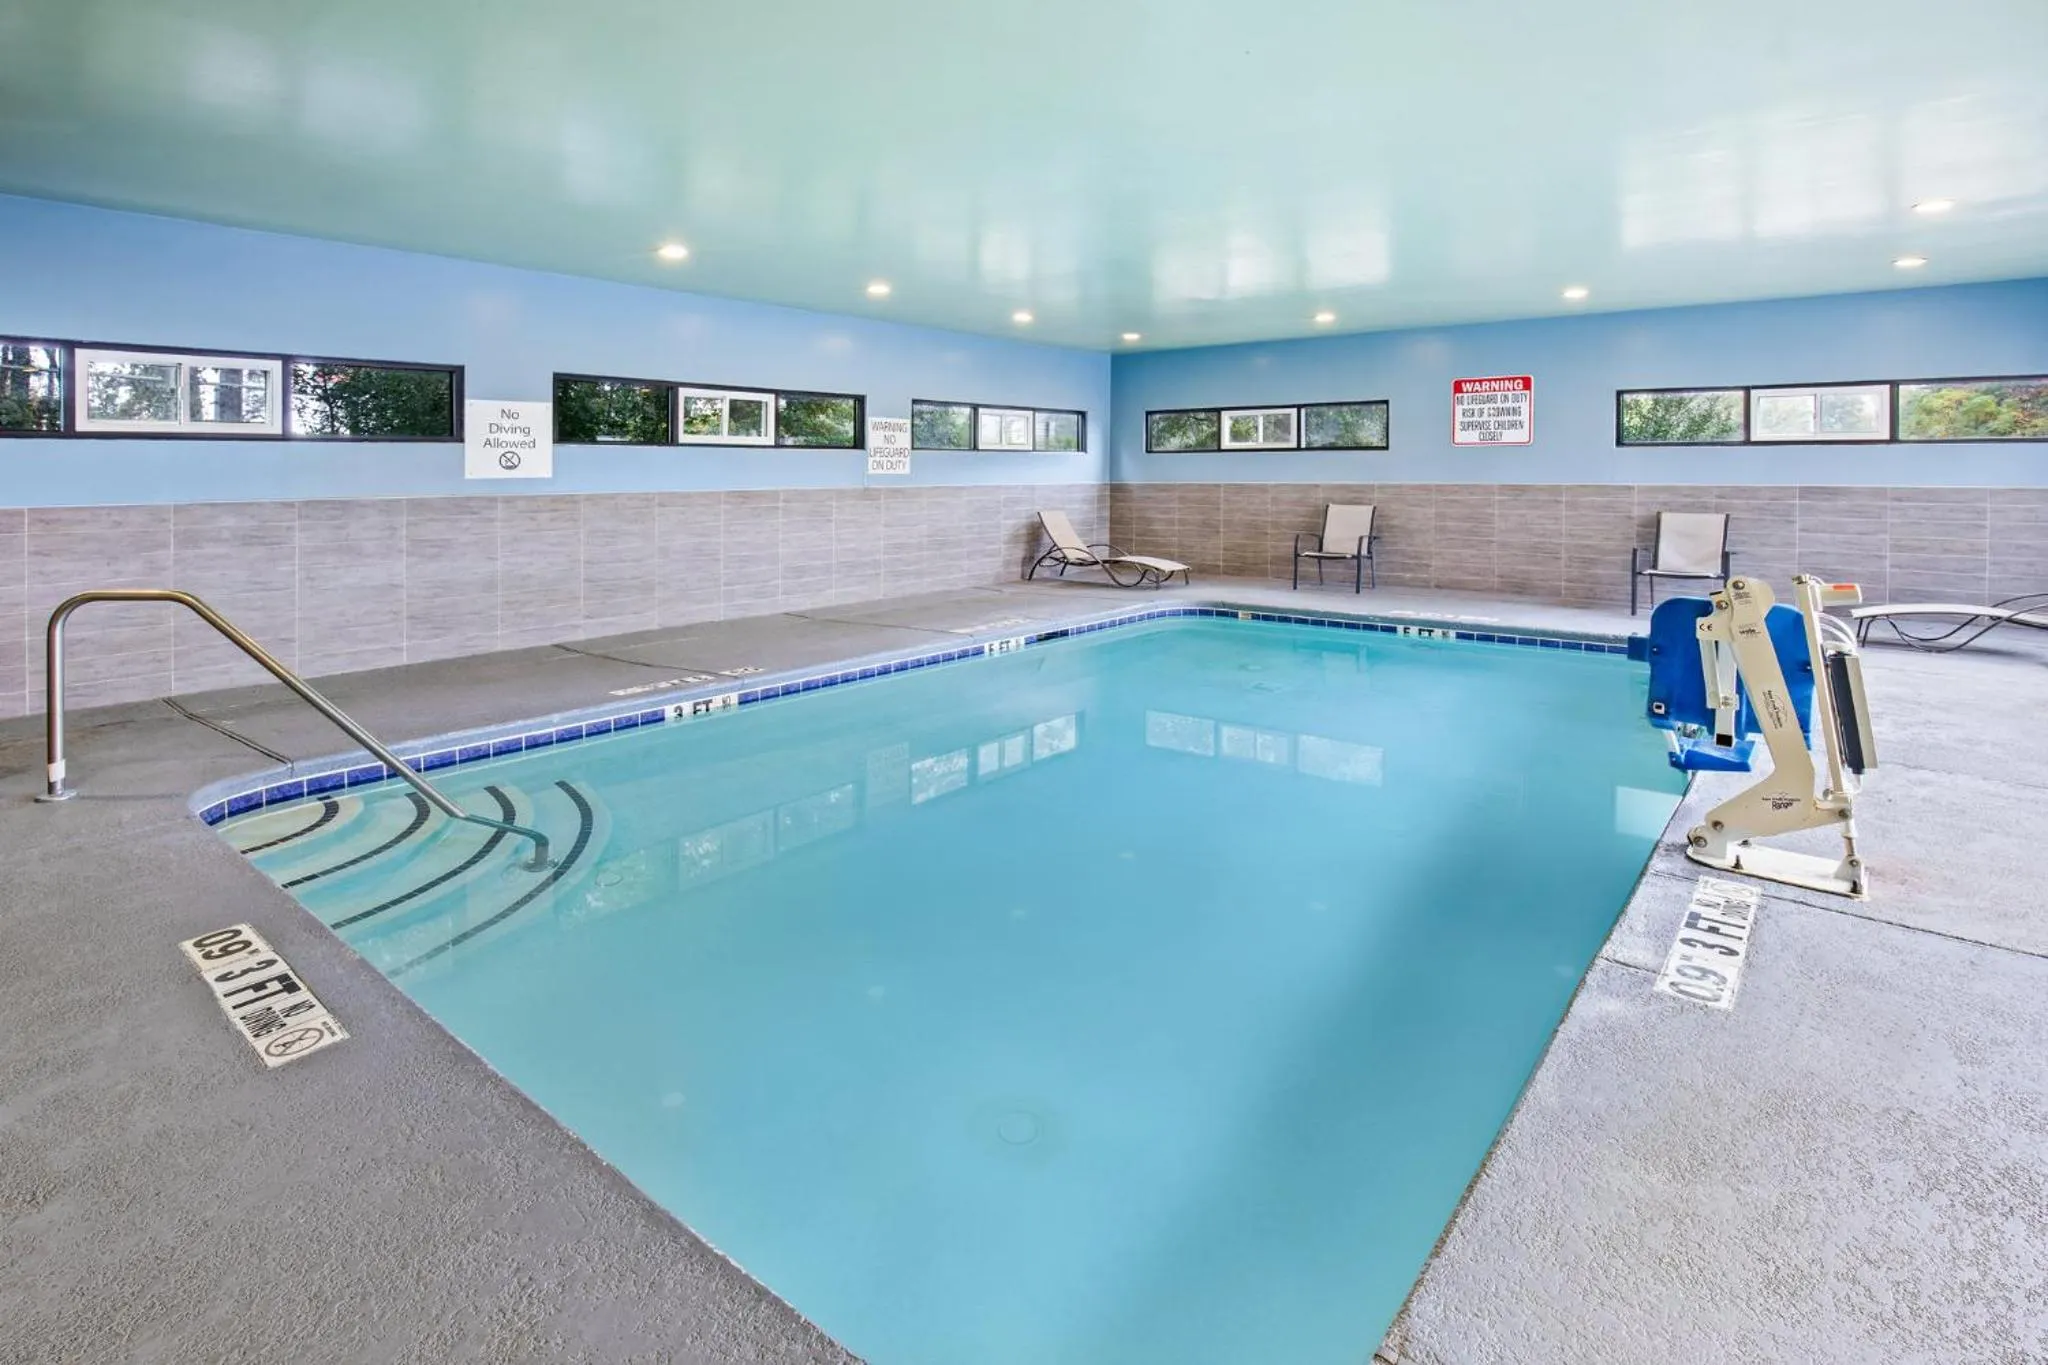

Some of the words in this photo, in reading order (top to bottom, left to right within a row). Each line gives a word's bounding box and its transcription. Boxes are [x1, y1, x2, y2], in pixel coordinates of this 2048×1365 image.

[1461, 379, 1524, 392] WARNING
[1467, 394, 1499, 405] LIFEGUARD
[1500, 393, 1510, 404] ON
[1511, 392, 1528, 403] DUTY
[500, 408, 520, 420] No
[1461, 407, 1476, 418] RISK
[1477, 407, 1485, 418] OF
[489, 422, 531, 437] Diving
[872, 421, 908, 433] WARNING
[1459, 420, 1492, 432] SUPERVISE
[1493, 419, 1525, 431] CHILDREN
[482, 437, 536, 449] Allowed
[884, 434, 897, 445] NO
[869, 447, 909, 458] LIFEGUARD
[872, 459, 884, 470] ON
[886, 459, 907, 470] DUTY
[692, 699, 713, 715] FT
[1683, 911, 1747, 941] FT
[1678, 937, 1740, 957] 3
[214, 959, 279, 982] 3
[223, 972, 302, 1010] FT
[279, 998, 316, 1019] NO
[239, 1006, 287, 1038] DIVING
